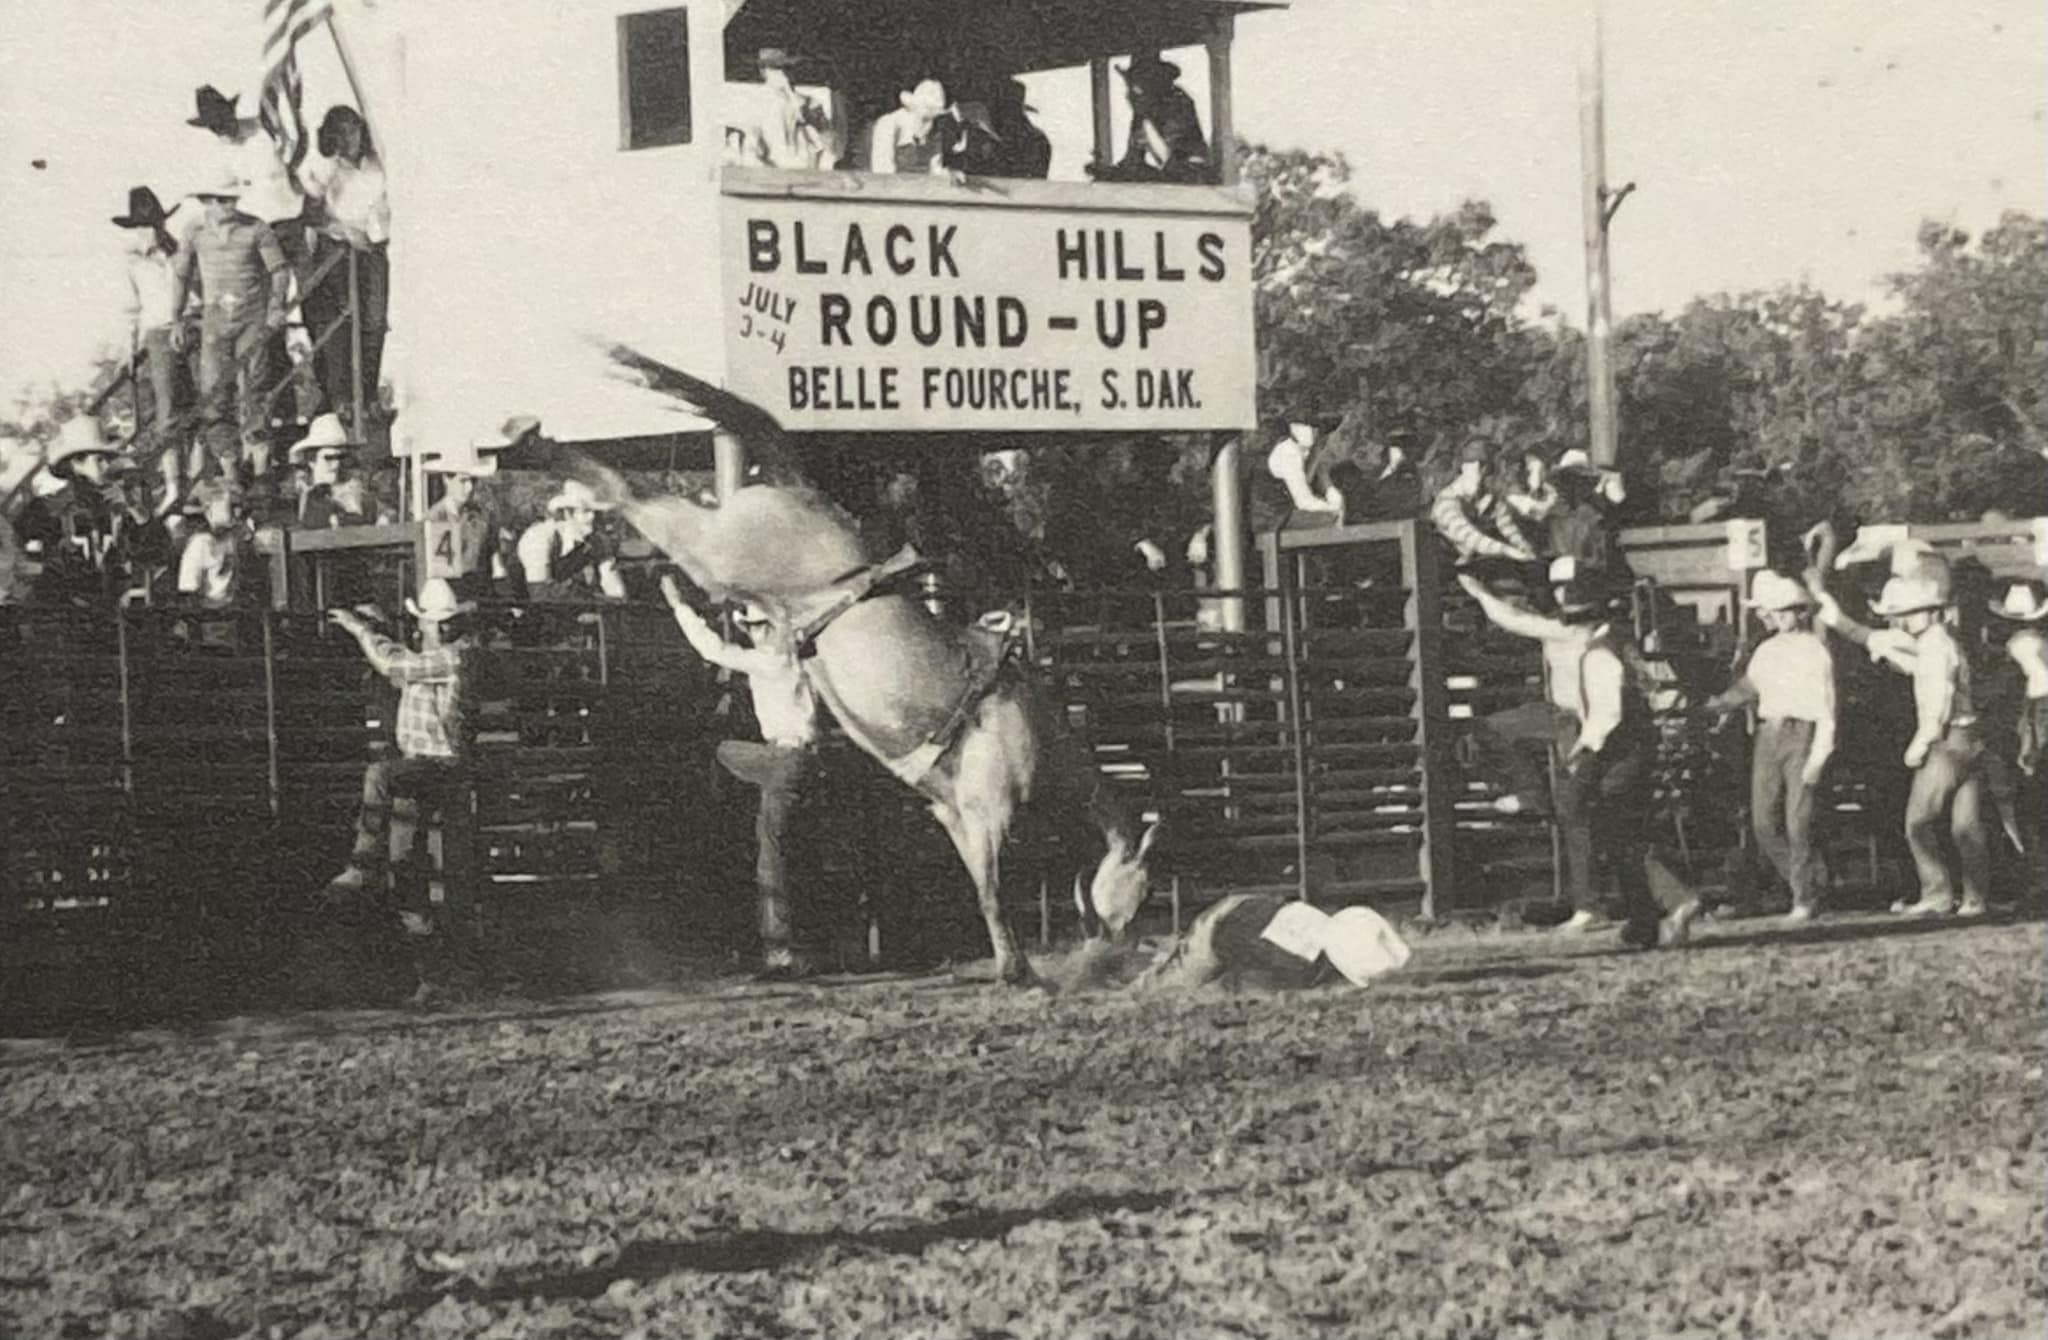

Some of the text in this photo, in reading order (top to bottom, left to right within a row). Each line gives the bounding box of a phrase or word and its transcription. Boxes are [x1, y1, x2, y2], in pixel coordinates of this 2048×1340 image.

[747, 219, 1226, 281] BLACK HILLS
[738, 281, 797, 324] JULY
[788, 365, 900, 410] BELLE
[922, 367, 1082, 415] FOURCHE,
[435, 529, 456, 566] 4
